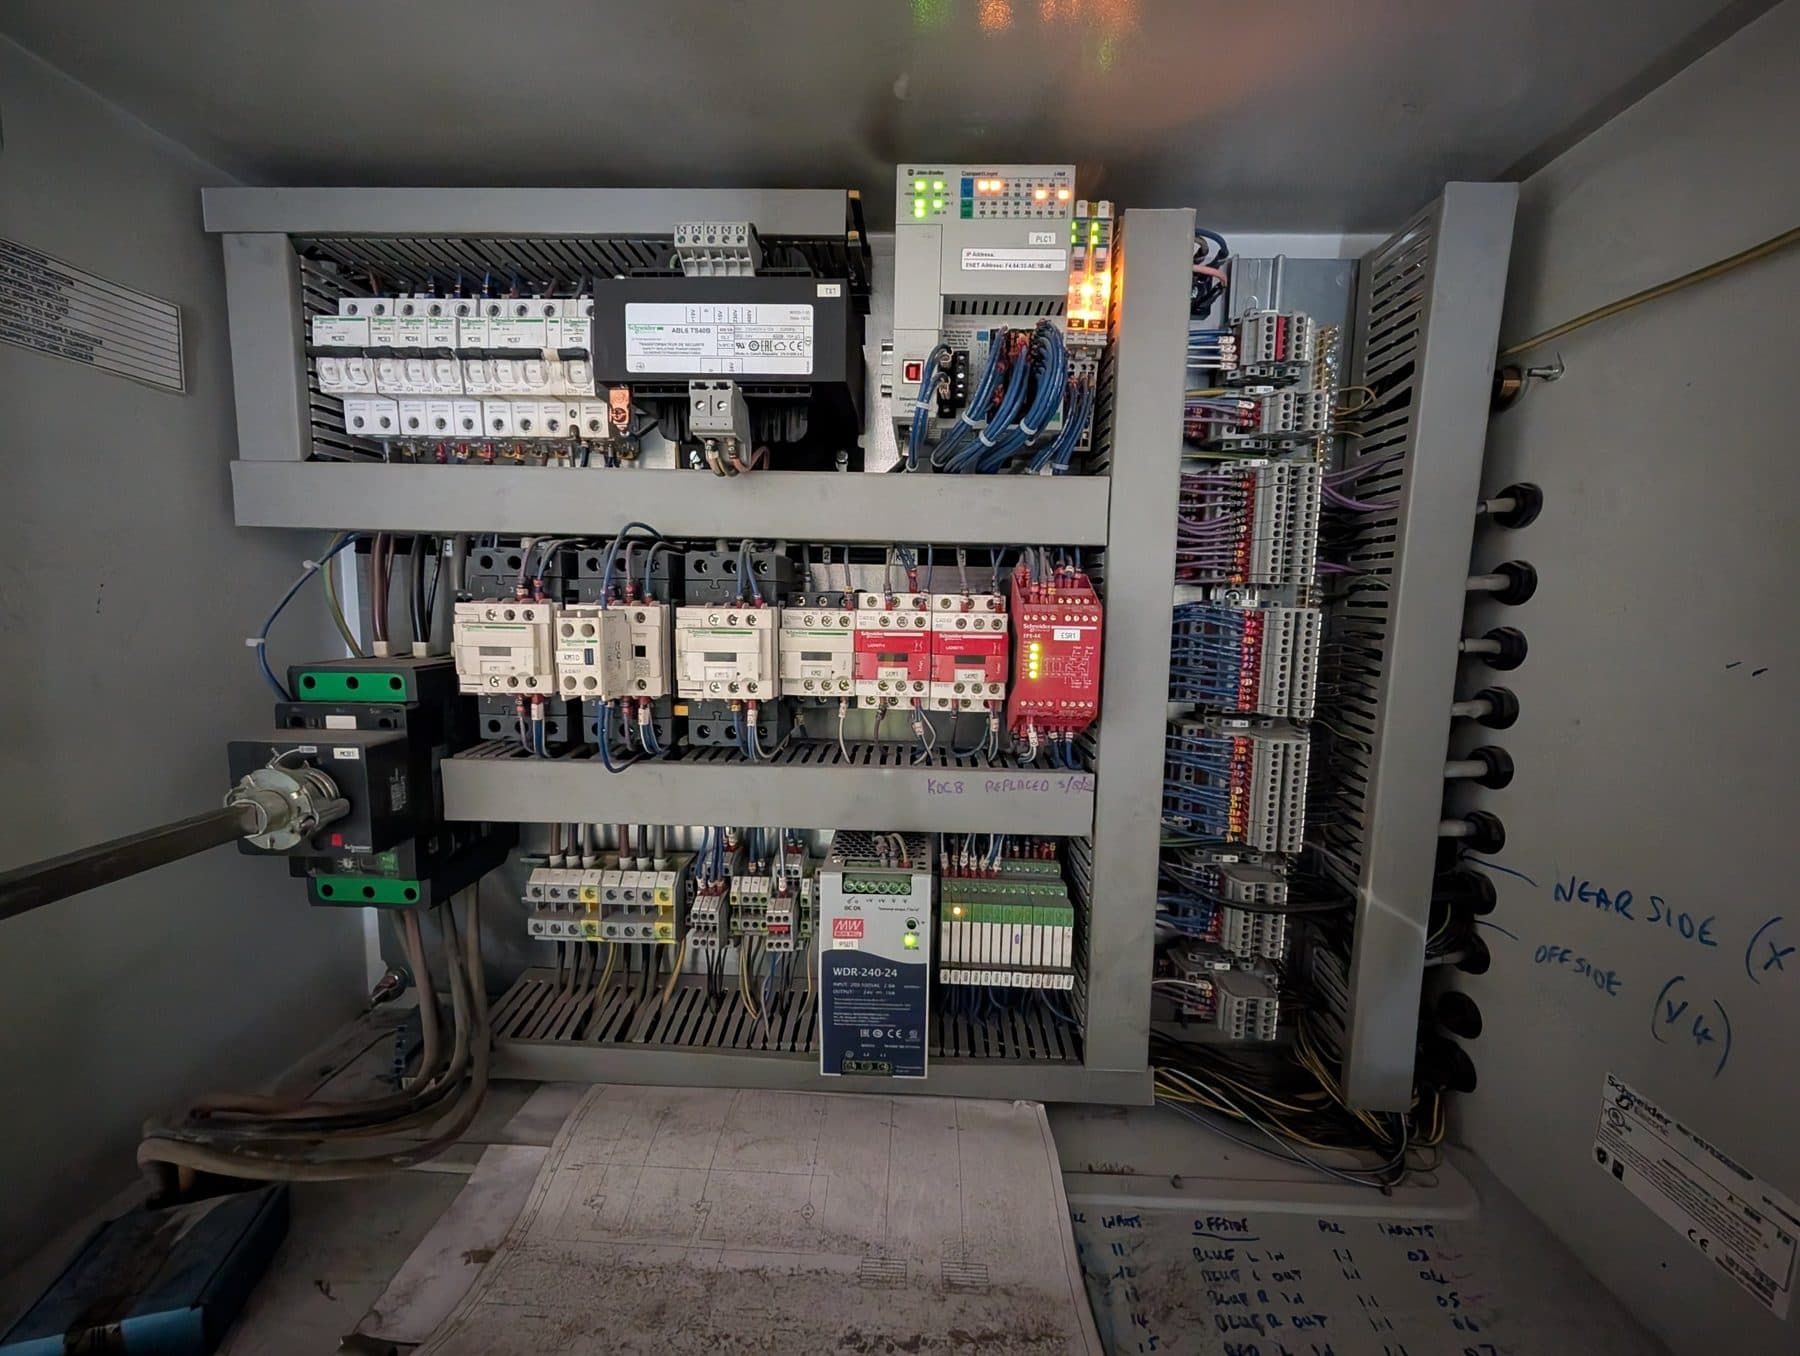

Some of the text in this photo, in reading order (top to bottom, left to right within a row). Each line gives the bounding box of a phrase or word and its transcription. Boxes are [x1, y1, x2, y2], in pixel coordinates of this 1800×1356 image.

[985, 779, 1049, 792] REPLACED
[833, 967, 898, 978] WDR-240-24
[1607, 1074, 1672, 1125] Schneider
